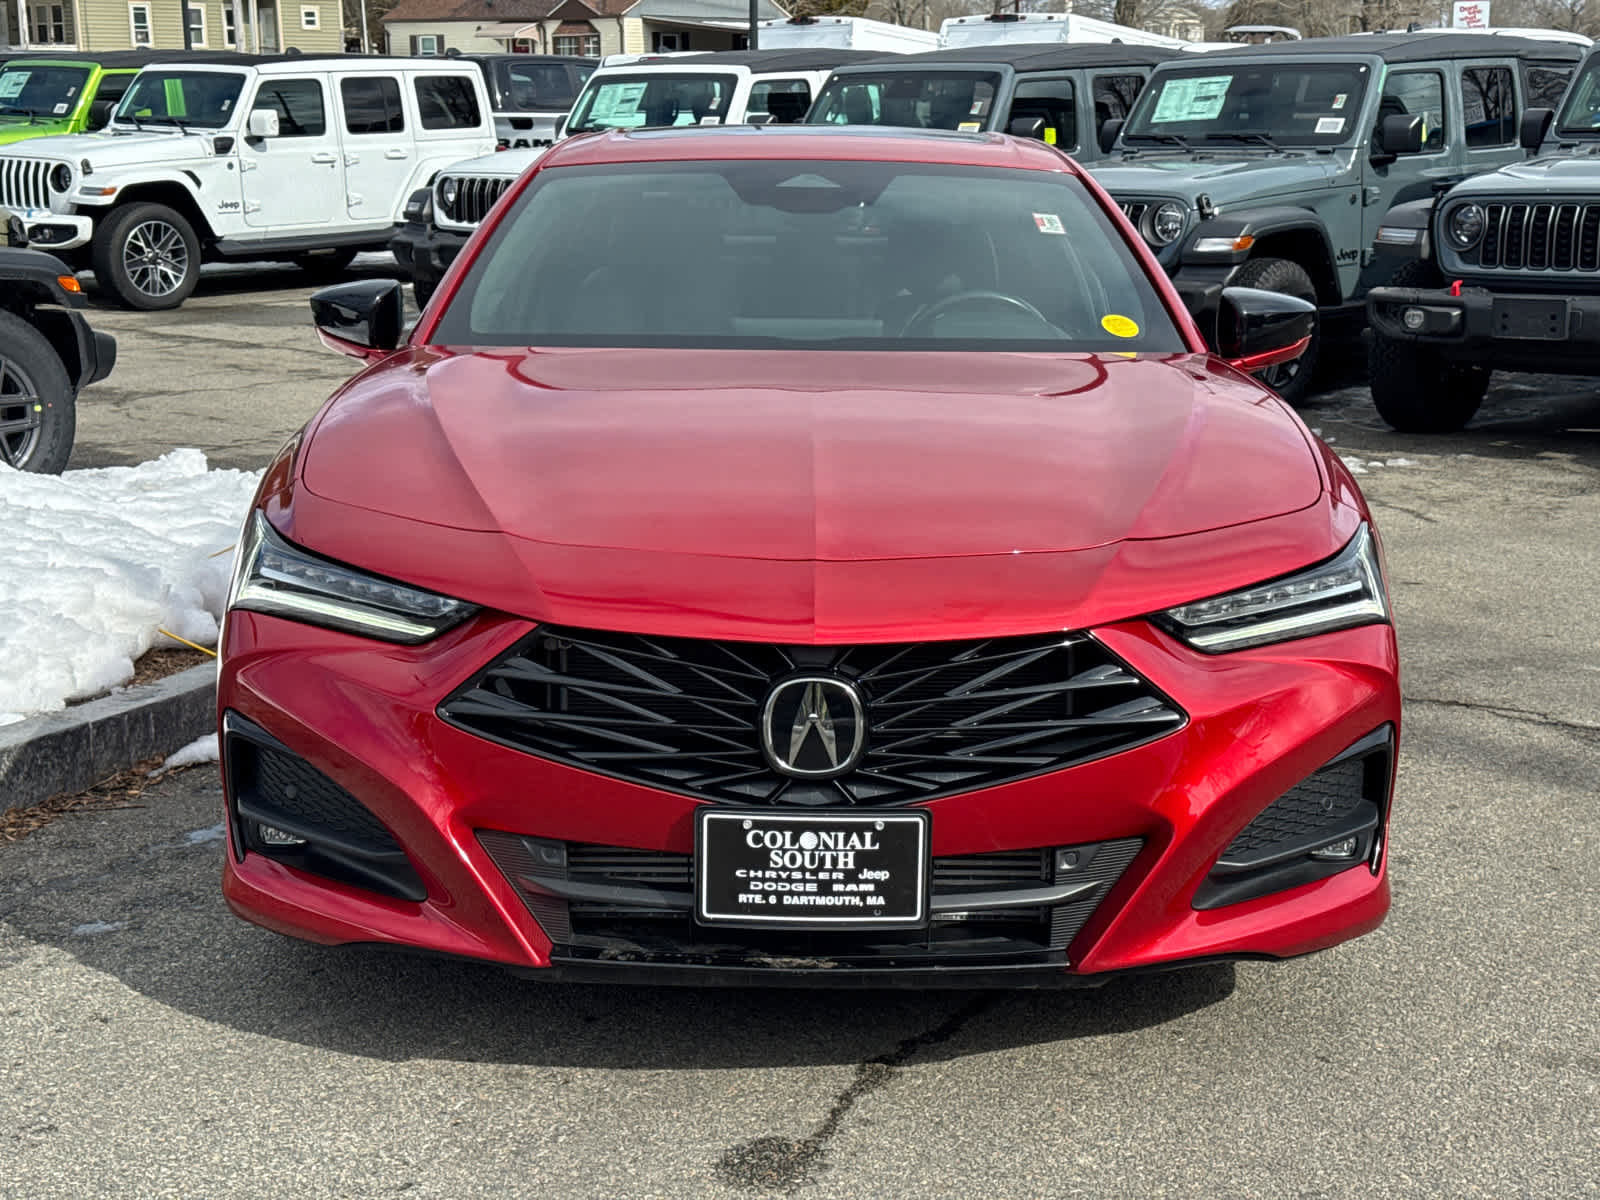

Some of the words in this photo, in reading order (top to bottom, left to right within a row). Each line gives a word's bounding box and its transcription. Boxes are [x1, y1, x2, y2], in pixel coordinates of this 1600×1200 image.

[497, 138, 553, 149] RAM
[218, 199, 240, 210] Jeep
[745, 830, 880, 850] COLONIAL
[769, 851, 856, 869] SOUTH
[735, 869, 845, 880] CHRYSLER
[858, 868, 890, 881] Jeep
[749, 881, 818, 892] DODGE
[832, 883, 875, 892] RAM
[738, 894, 766, 904] RTE.
[768, 895, 777, 905] 6
[782, 895, 864, 907] DARTMOUTH,
[865, 896, 886, 906] MA
